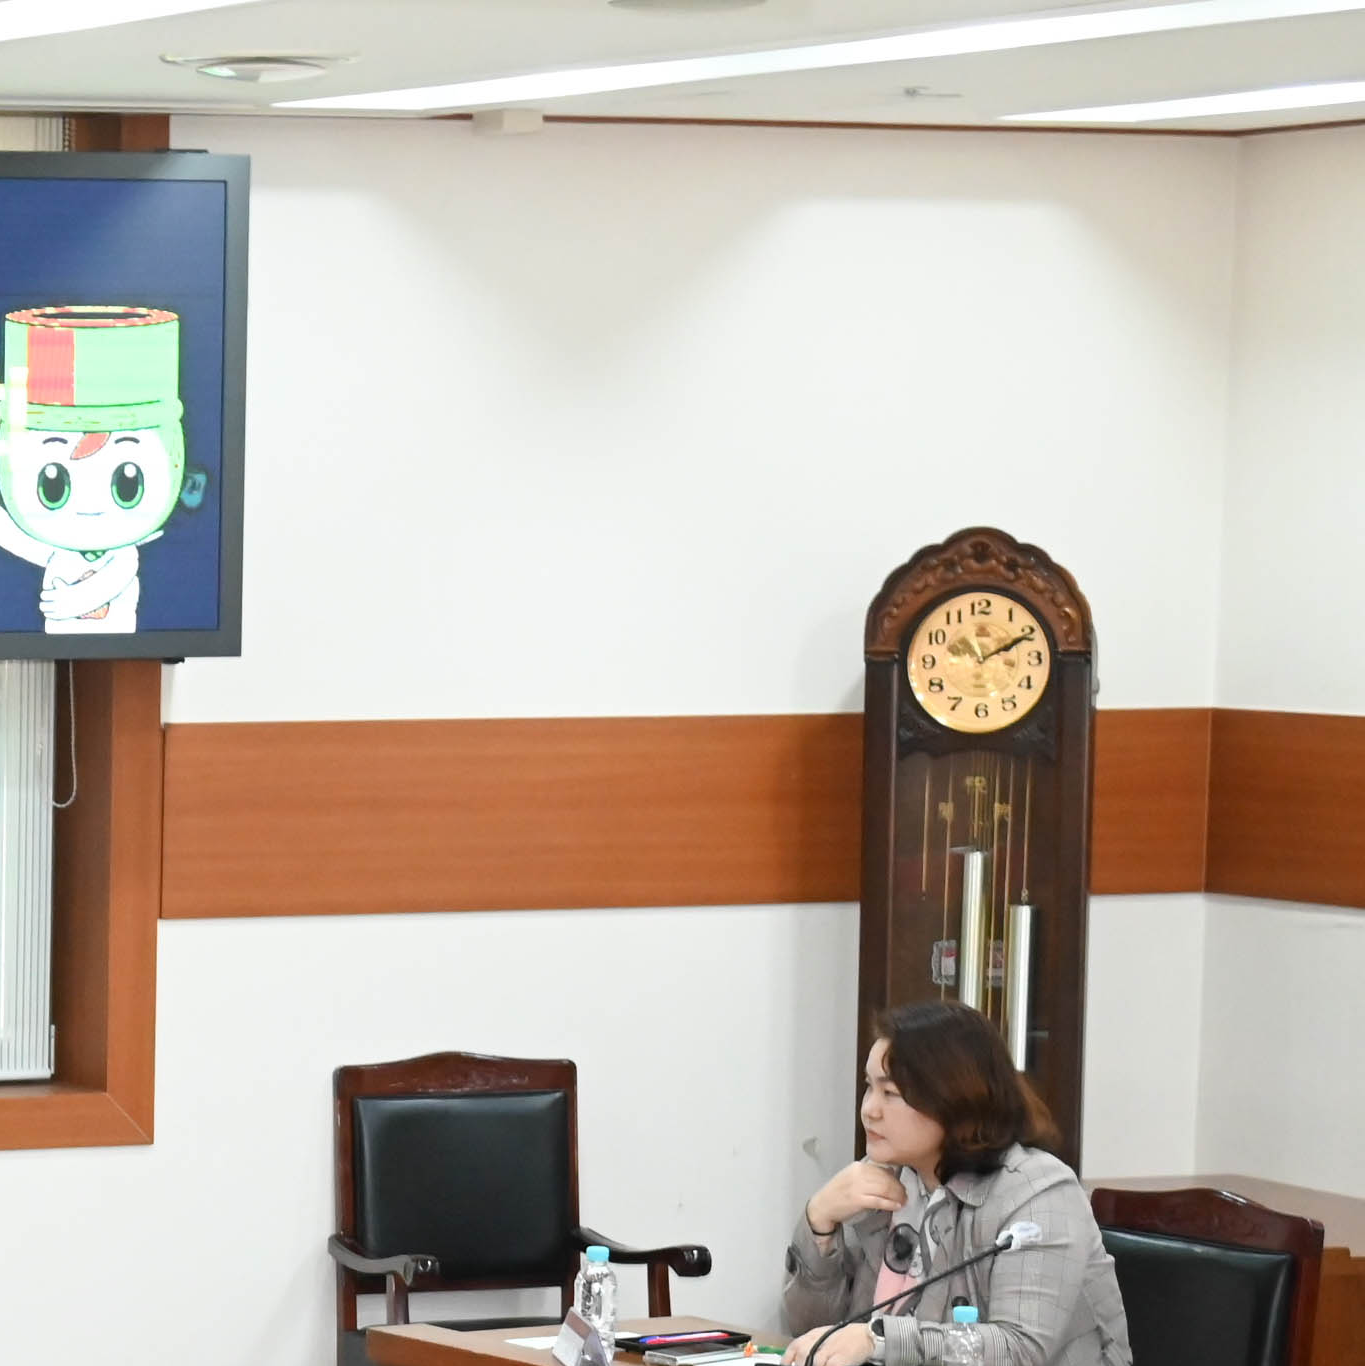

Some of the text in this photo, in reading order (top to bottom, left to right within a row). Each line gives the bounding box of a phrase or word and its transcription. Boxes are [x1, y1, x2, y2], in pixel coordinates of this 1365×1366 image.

[970, 599, 991, 616] 12
[946, 608, 962, 625] 11
[928, 628, 946, 646] 10
[1021, 625, 1035, 641] 2
[922, 654, 936, 669] 9
[1028, 651, 1042, 666] 3
[928, 677, 944, 693] 8
[1017, 675, 1032, 690] 4
[947, 696, 962, 711] 7
[975, 703, 989, 718] 6
[1002, 695, 1017, 711] 5
